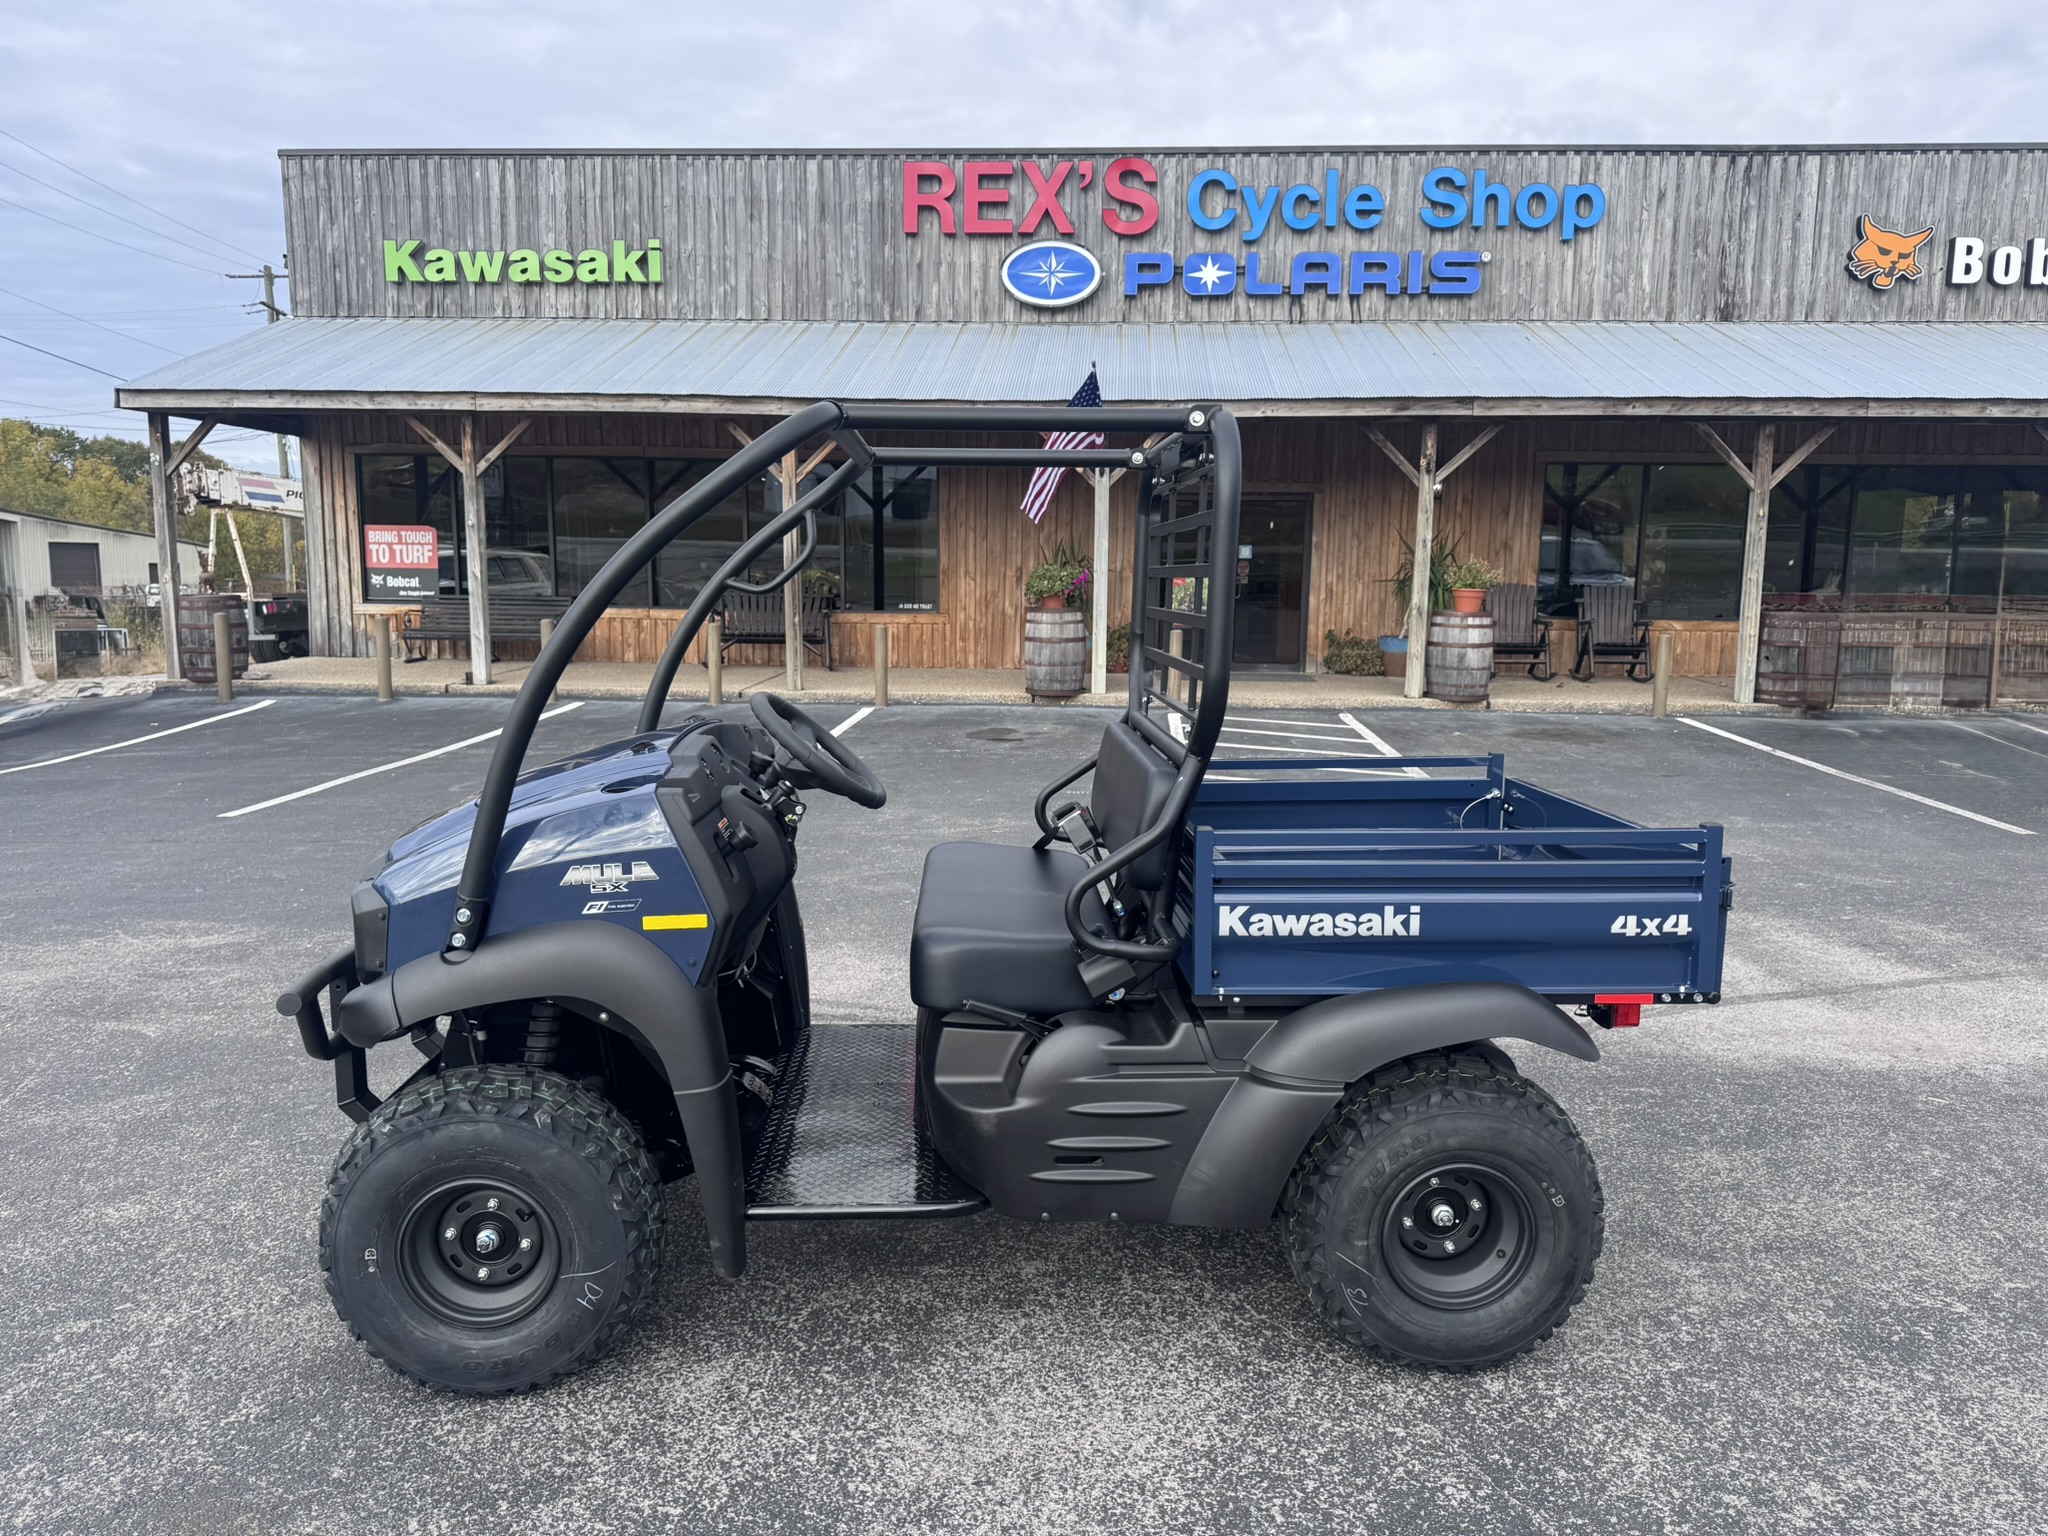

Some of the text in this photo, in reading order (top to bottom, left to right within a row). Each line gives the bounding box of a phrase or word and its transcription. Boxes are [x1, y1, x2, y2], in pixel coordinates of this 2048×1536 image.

[903, 157, 1606, 242] REX'S Cycle Shop
[383, 239, 663, 283] Kawasaki
[368, 530, 433, 544] BRING TOUGH
[369, 543, 433, 564] TO TURF
[386, 575, 420, 588] Bobcat
[559, 861, 660, 887] MULE
[590, 882, 629, 894] SX
[1218, 905, 1421, 937] Kawasaki
[1610, 914, 1693, 937] 4x4
